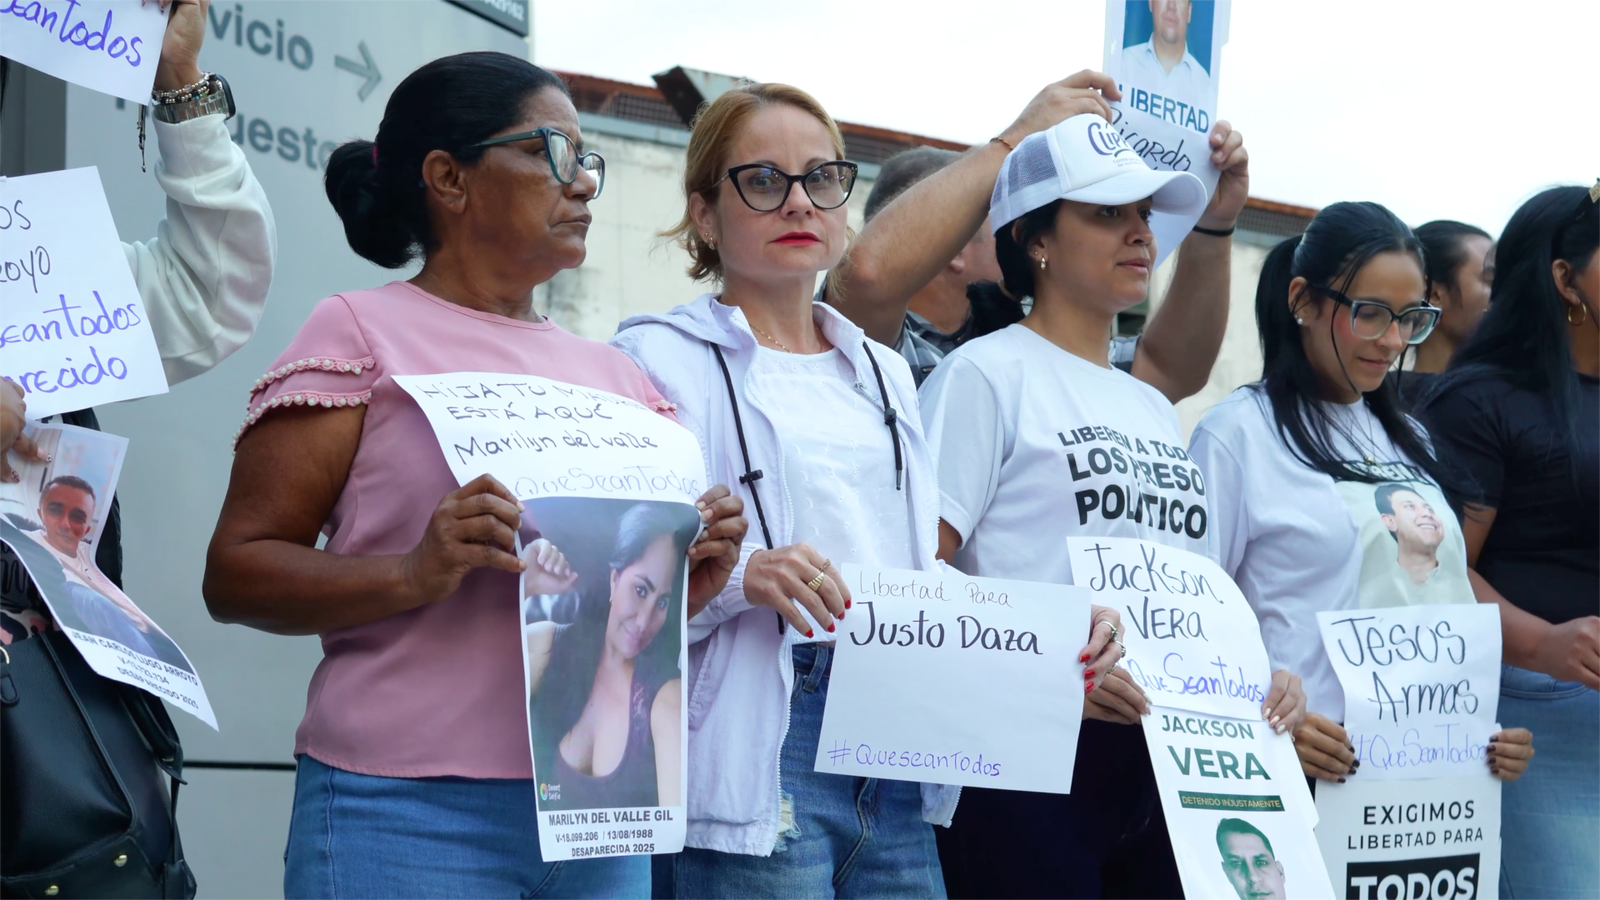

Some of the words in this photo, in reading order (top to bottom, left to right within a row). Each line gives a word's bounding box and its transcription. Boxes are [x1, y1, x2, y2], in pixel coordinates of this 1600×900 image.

[0, 345, 128, 393] recido
[446, 401, 525, 420] ESTÁ
[453, 430, 557, 465] Marilyn
[562, 429, 599, 449] del
[1134, 437, 1150, 456] A
[1149, 439, 1195, 463] TOD
[1066, 447, 1128, 482] LOS
[859, 571, 951, 601] Libertad
[849, 601, 945, 648] Justo
[956, 615, 1044, 655] Daza
[163, 664, 198, 686] ARROYO
[1367, 671, 1478, 726] Armas
[1162, 714, 1255, 740] JACKSON
[1167, 745, 1272, 780] VERA
[1181, 795, 1221, 806] DETENIDO
[1222, 797, 1282, 808] INJUSTAMENTE
[1363, 800, 1475, 825] EXIGIMOS
[548, 812, 588, 826] MARILYN
[591, 812, 610, 824] DEL
[613, 810, 650, 822] VALLE
[654, 809, 673, 821] GIL
[555, 831, 598, 843] V-18.099.206
[607, 829, 653, 840] 13/08/1988
[1348, 831, 1436, 849] LIBERTAD
[1443, 827, 1483, 844] PARA
[571, 844, 631, 857] DESAPARECIDA
[632, 843, 655, 853] 2025
[1350, 866, 1475, 900] TODOS
